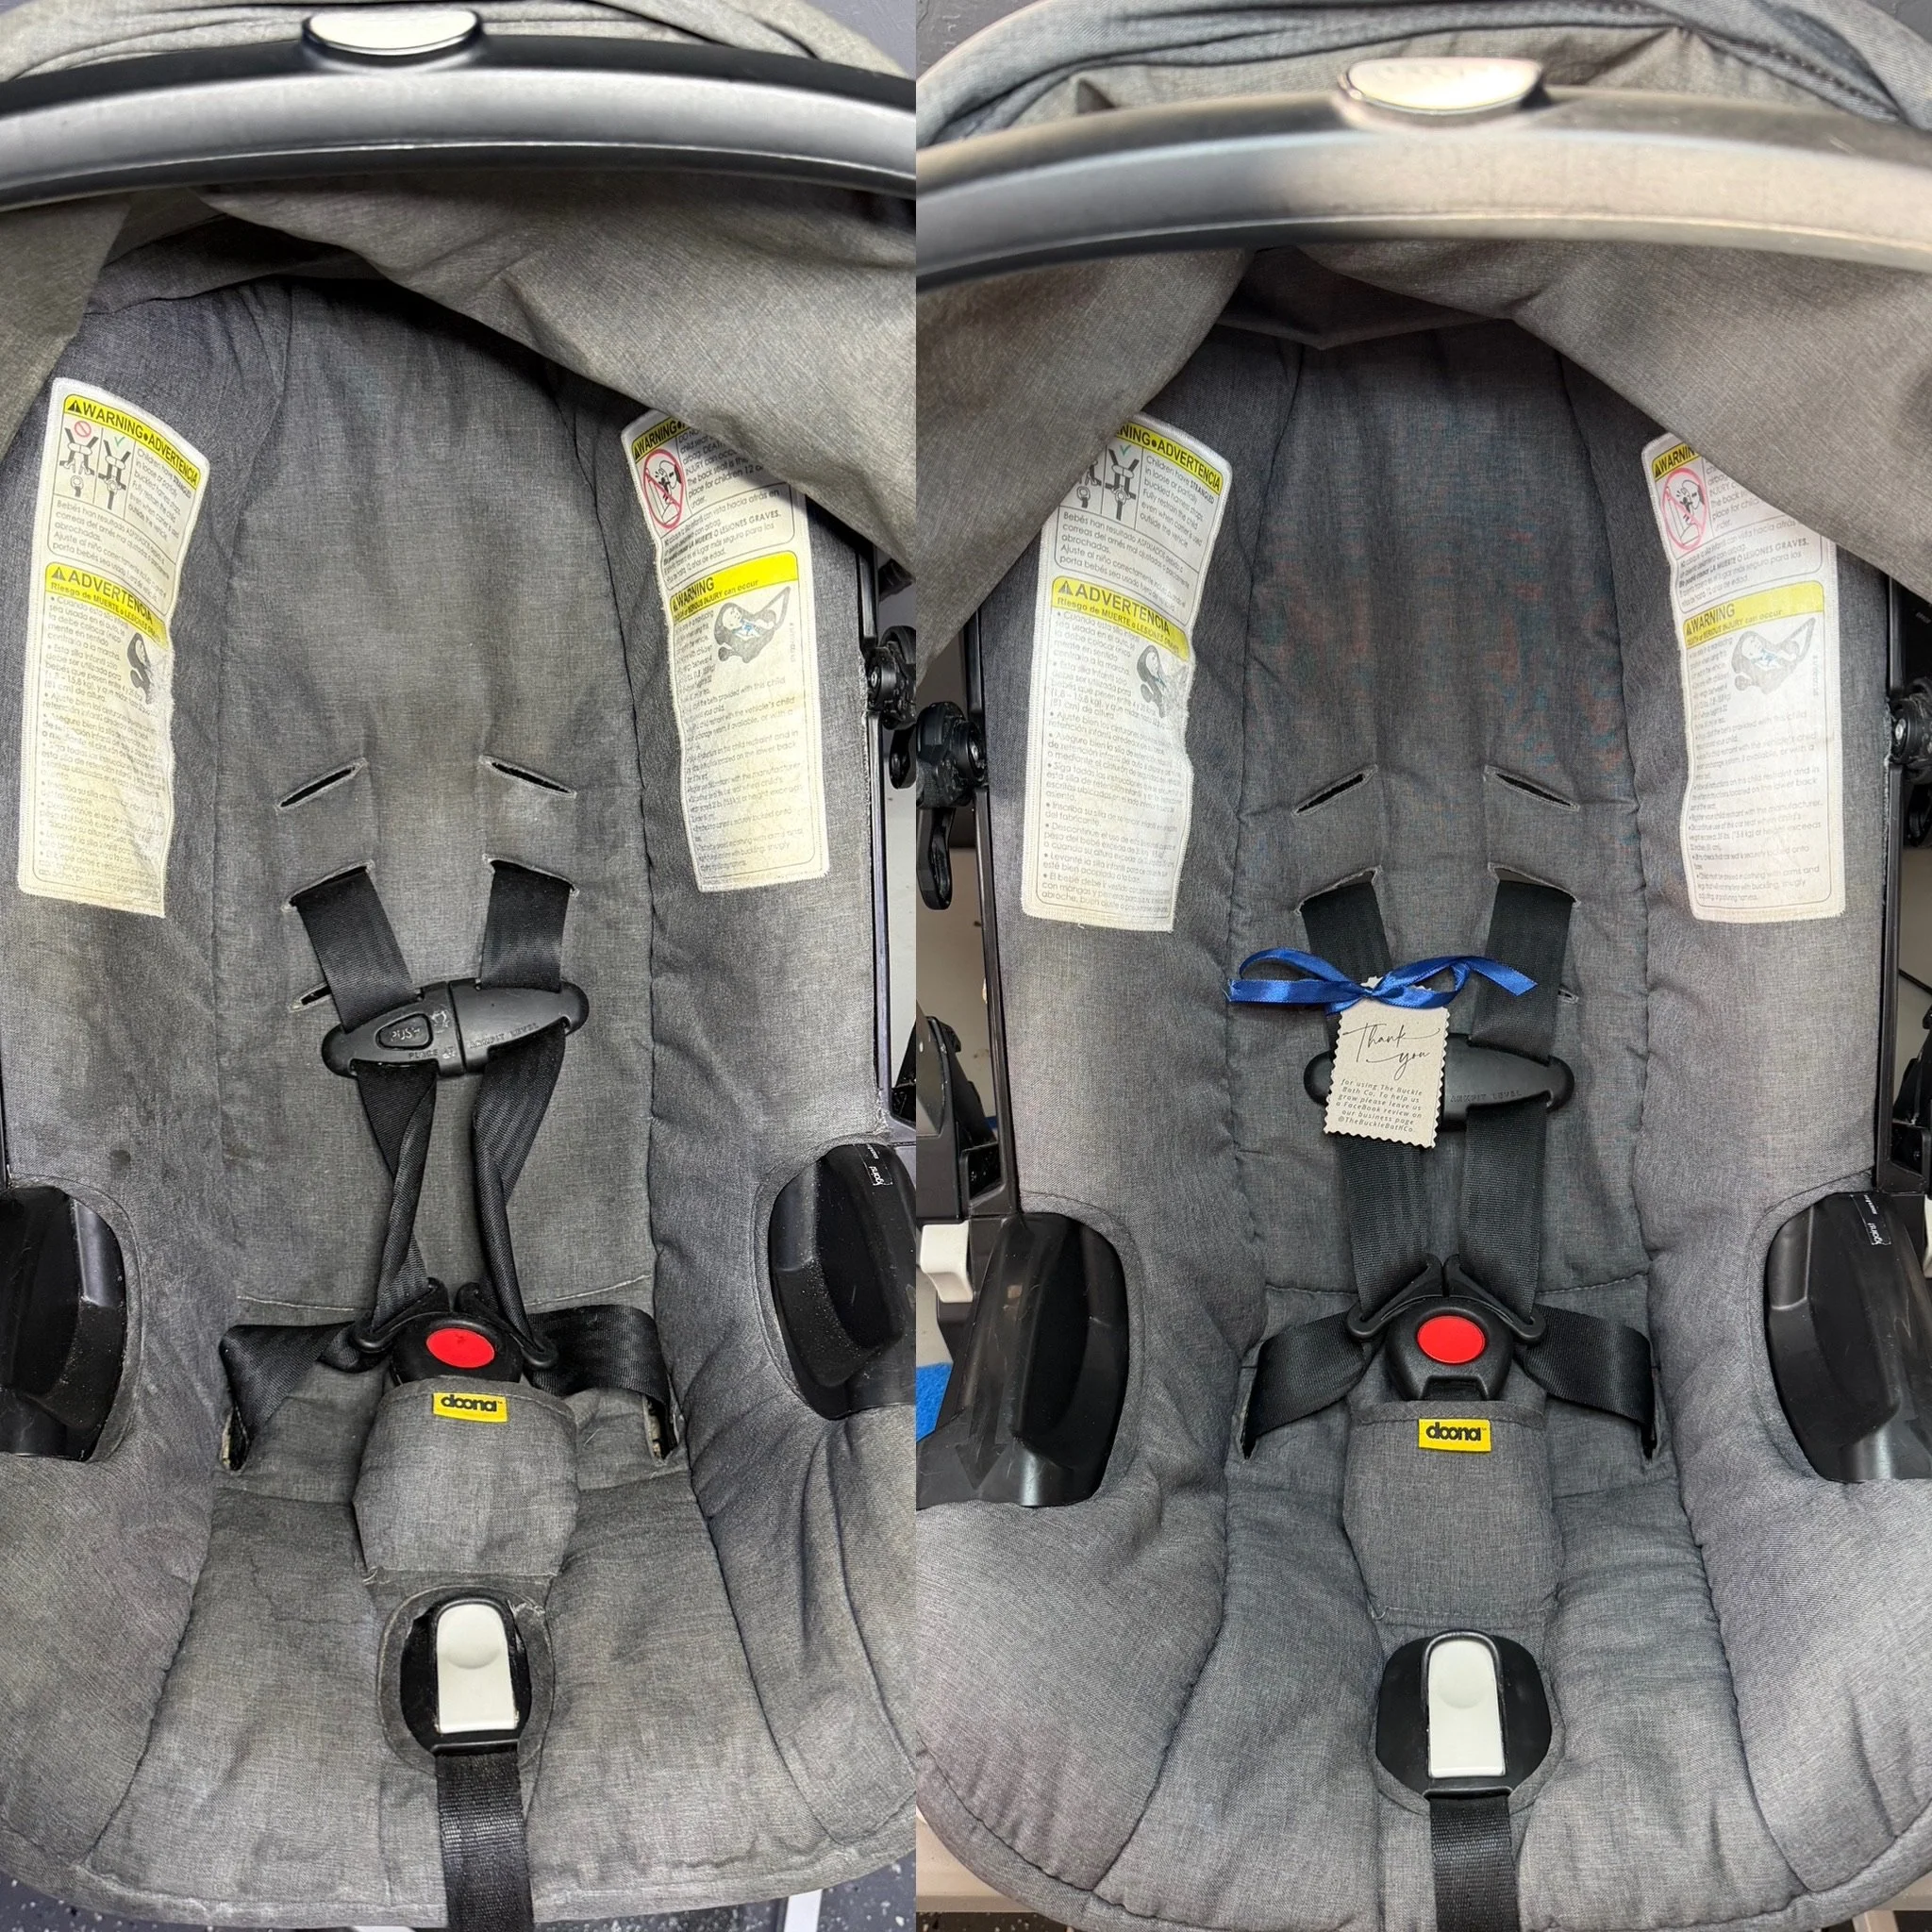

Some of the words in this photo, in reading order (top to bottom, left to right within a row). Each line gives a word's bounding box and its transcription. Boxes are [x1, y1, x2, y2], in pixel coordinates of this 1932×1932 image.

[83, 402, 143, 439] WARNING
[148, 434, 197, 486] ADVERTENCIA
[638, 421, 676, 455] WARNING
[1146, 456, 1174, 475] Children
[1158, 440, 1220, 491] ADVERTENCIA
[1660, 445, 1695, 474] WARNIN
[714, 469, 743, 484] children
[744, 465, 754, 475] 12
[726, 498, 747, 511] hacia
[749, 491, 767, 503] atrás
[719, 519, 747, 534] LESIONES
[749, 510, 781, 524] GRAVES.
[1064, 511, 1089, 525] Bebés
[1775, 519, 1797, 529] atrás
[745, 526, 762, 537] para
[1062, 524, 1092, 536] correas
[1094, 530, 1106, 540] del
[1060, 544, 1085, 556] Ajuste
[1060, 556, 1083, 566] porta
[1085, 560, 1108, 574] bebés
[676, 577, 715, 607] WARNING
[724, 587, 736, 596] can
[737, 579, 759, 591] occur
[68, 570, 153, 625] ADVERTENCIA
[1075, 583, 1170, 635] ADVERTENCIA
[1090, 606, 1099, 614] de
[1102, 608, 1131, 626] MUERTE
[1690, 604, 1736, 634] WARNING
[775, 696, 795, 707] child
[1342, 1023, 1441, 1062] Thank
[1366, 1053, 1430, 1080] you
[1357, 1081, 1377, 1090] using
[1397, 1087, 1423, 1096] Buckle
[1492, 1090, 1522, 1100] LEVEL
[1344, 1102, 1380, 1111] FaceBook
[1383, 1108, 1409, 1116] review
[1359, 1096, 1386, 1106] please
[1389, 1099, 1409, 1108] leave
[1358, 1112, 1392, 1122] business
[441, 1394, 496, 1412] doona
[1426, 1422, 1481, 1441] doona
